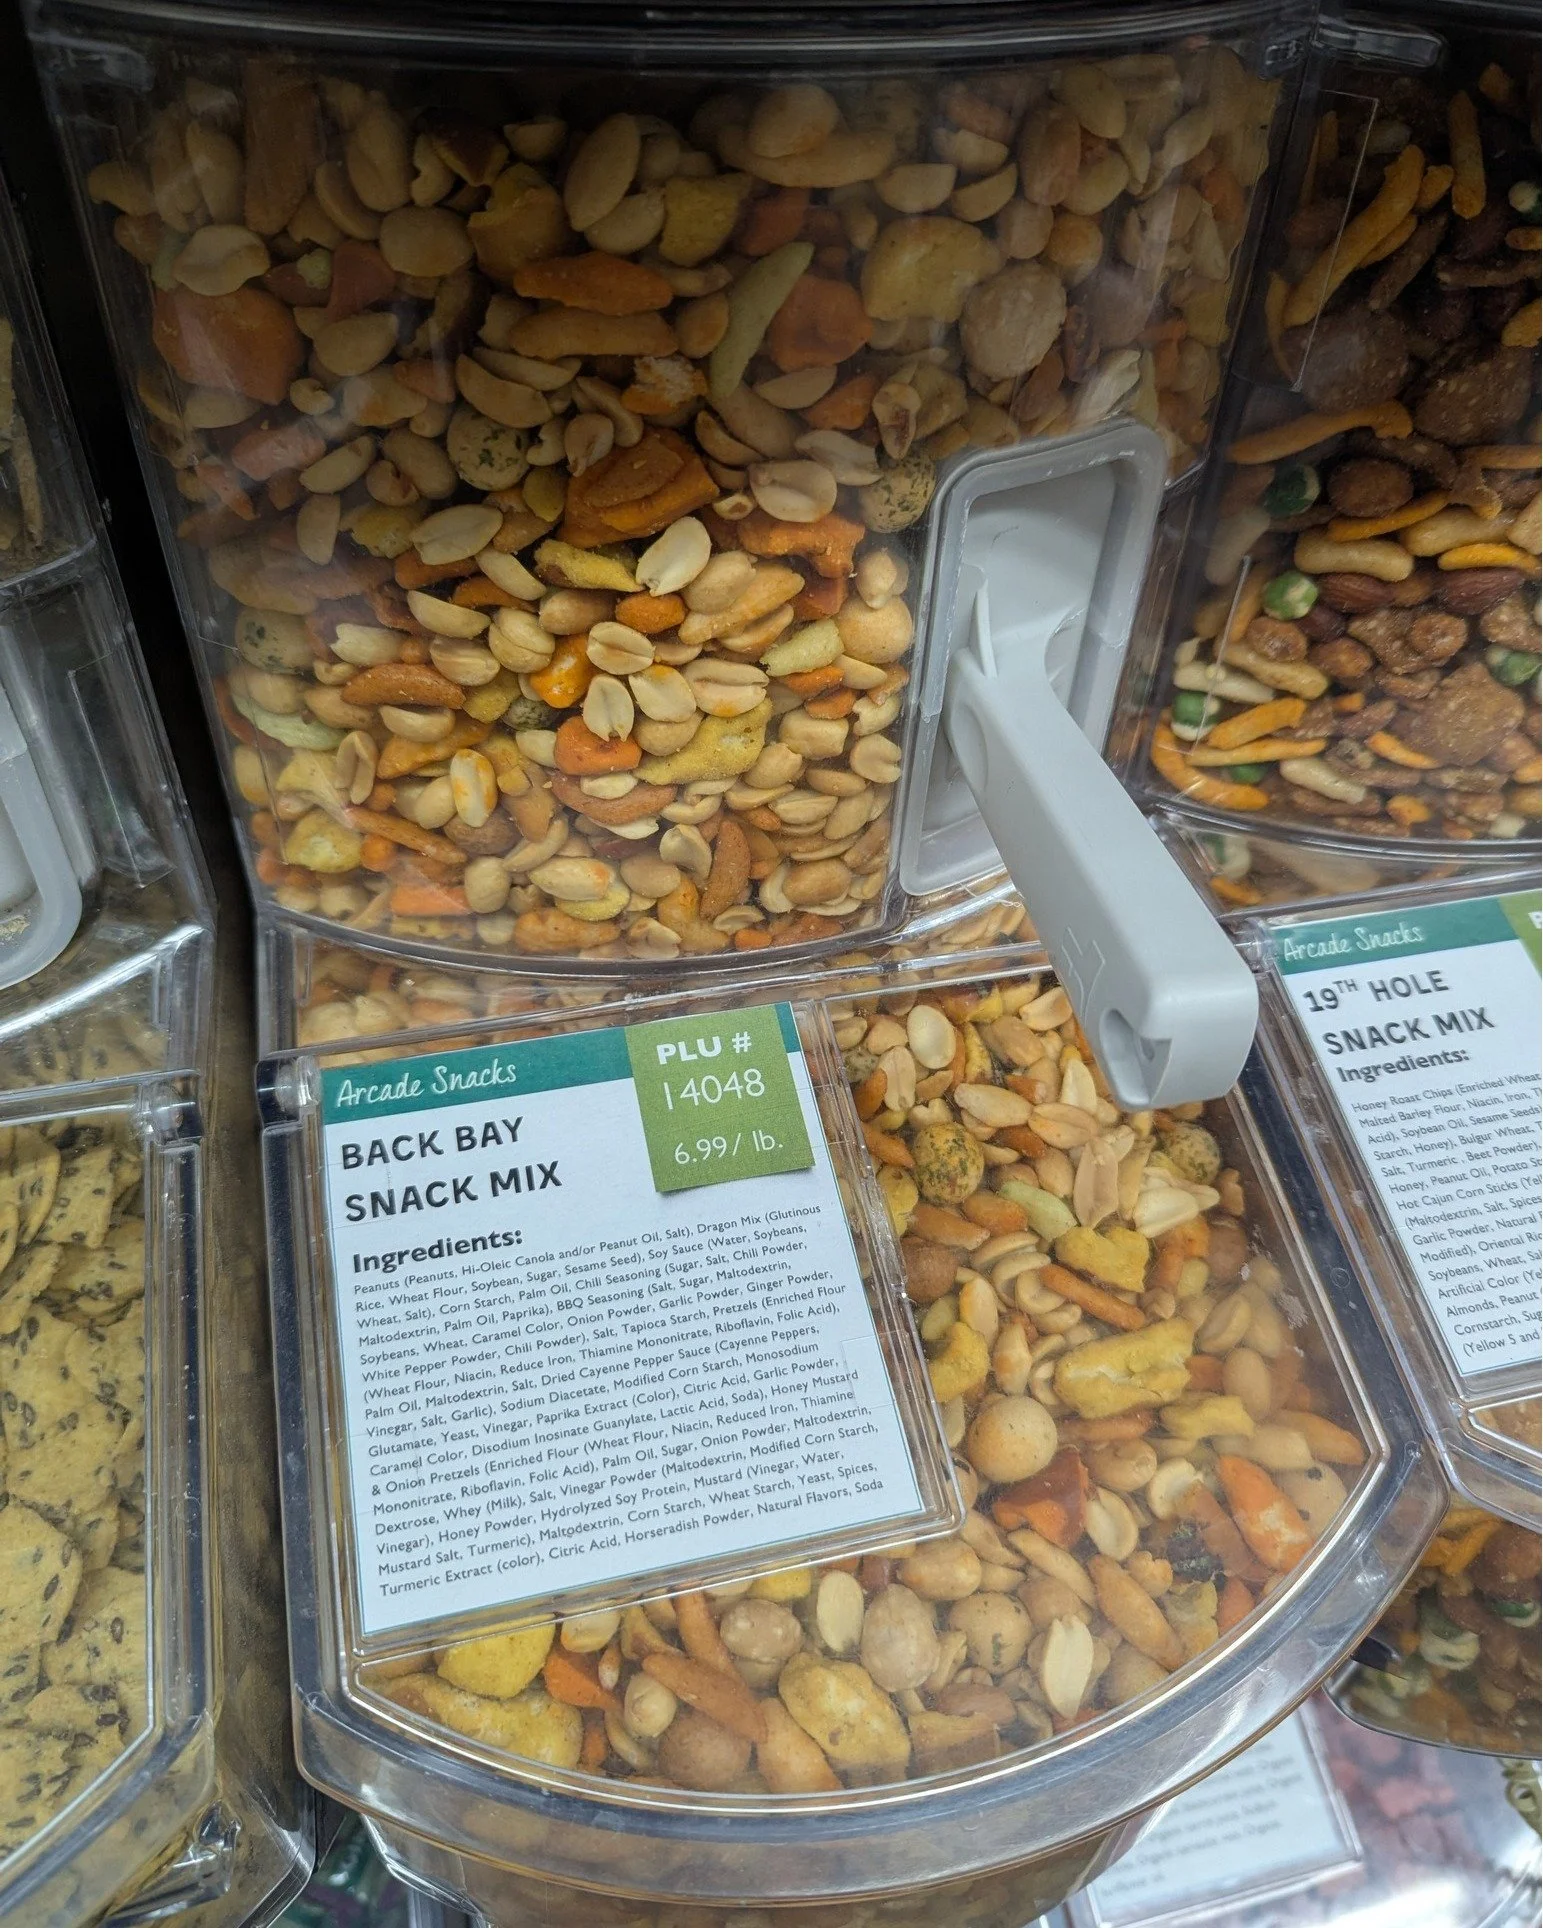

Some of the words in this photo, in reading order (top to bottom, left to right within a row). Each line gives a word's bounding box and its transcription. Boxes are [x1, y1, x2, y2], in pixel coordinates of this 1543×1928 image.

[1281, 932, 1352, 961] Arcade
[1353, 921, 1425, 951] Snacks
[1367, 969, 1450, 1002] HOLE
[656, 1035, 722, 1065] PLU
[731, 1030, 752, 1053] #
[1321, 1017, 1431, 1055] SNACK
[1431, 1006, 1495, 1036] MIX
[336, 1072, 425, 1107] Arcade
[430, 1057, 516, 1094] Snacks
[663, 1068, 765, 1110] 14048
[1335, 1049, 1470, 1083] Ingredients:
[341, 1129, 444, 1170] BACK
[454, 1115, 523, 1152] BAY
[674, 1132, 741, 1164] 6.99/
[751, 1129, 783, 1152] lb.
[344, 1174, 479, 1222] SNACK
[489, 1159, 563, 1198] MIX
[352, 1229, 523, 1274] Ingredients:
[353, 1279, 400, 1295] Peanuts
[403, 1270, 458, 1288] (Peanuts,
[461, 1259, 511, 1276] Hi-Oleic
[514, 1251, 555, 1267] Canola
[558, 1244, 596, 1260] and/or
[599, 1237, 638, 1252] Peanut
[640, 1231, 662, 1245] Oil,
[664, 1225, 694, 1240] Salt),
[696, 1220, 738, 1234] Dragon
[740, 1215, 762, 1227] Mix
[765, 1204, 821, 1224] (Glutinous
[354, 1300, 384, 1313] Rice,
[387, 1292, 429, 1306] Wheat
[432, 1285, 468, 1299] Flour,
[470, 1276, 523, 1292] Soybean,
[526, 1269, 561, 1283] Sugar,
[563, 1260, 607, 1276] Sesame
[609, 1251, 645, 1267] Seed),
[647, 1248, 668, 1261] Soy
[671, 1242, 704, 1255] Sauce
[707, 1232, 751, 1252] (Water,
[752, 1223, 807, 1242] Soybeans,
[356, 1313, 401, 1329] Wheat,
[404, 1306, 435, 1321] Salt),
[438, 1302, 470, 1315] Corn
[472, 1292, 515, 1310] Starch,
[518, 1288, 547, 1301] Palm
[549, 1282, 572, 1295] Oil,
[573, 1275, 602, 1290] Chili
[604, 1267, 662, 1285] Seasoning
[663, 1260, 703, 1276] (Sugar,
[703, 1253, 730, 1266] Salt,
[732, 1247, 759, 1261] Chili
[761, 1241, 807, 1256] Powder,
[358, 1324, 440, 1347] Maltodextrin,
[443, 1318, 472, 1332] Palm
[475, 1312, 498, 1326] Oil,
[501, 1302, 553, 1322] Paprika),
[556, 1296, 584, 1311] BBQ
[586, 1287, 645, 1306] Seasoning
[647, 1280, 676, 1297] (Salt,
[676, 1275, 713, 1289] Sugar,
[715, 1257, 791, 1281] Maltodextrin,
[359, 1347, 419, 1366] Soybeans,
[422, 1338, 468, 1353] Wheat,
[471, 1325, 521, 1345] Caramel
[524, 1320, 564, 1335] Color,
[566, 1313, 604, 1327] Onion
[607, 1303, 656, 1319] Powder,
[658, 1294, 693, 1310] Garlic
[696, 1286, 743, 1303] Powder,
[745, 1278, 784, 1293] Ginger
[786, 1269, 833, 1286] Powder,
[361, 1368, 401, 1382] White
[403, 1359, 447, 1376] Pepper
[451, 1350, 501, 1366] Powder,
[504, 1341, 532, 1356] Chili
[535, 1331, 590, 1350] Powder),
[592, 1326, 618, 1340] Salt,
[620, 1318, 667, 1335] Tapioca
[669, 1308, 710, 1325] Starch,
[712, 1299, 758, 1316] Pretzels
[760, 1288, 814, 1310] (Enriched
[816, 1284, 846, 1297] Flour
[375, 1533, 434, 1555] Vinegar),
[438, 1525, 480, 1543] Honey
[484, 1514, 536, 1533] Powder,
[540, 1494, 612, 1522] Hydrolyzed
[614, 1492, 637, 1506] Soy
[641, 1481, 690, 1500] Protein,
[693, 1467, 743, 1488] Mustard
[746, 1459, 799, 1480] (Vinegar,
[800, 1450, 844, 1465] Water,
[379, 1574, 440, 1596] Turmeric
[444, 1564, 493, 1583] Extract
[496, 1551, 545, 1574] (color),
[548, 1542, 585, 1559] Citric
[588, 1533, 621, 1551] Acid,
[624, 1517, 700, 1543] Horseradish
[702, 1508, 754, 1526] Powder,
[756, 1494, 803, 1515] Natural
[805, 1487, 852, 1504] Flavors,
[854, 1478, 884, 1493] Soda
